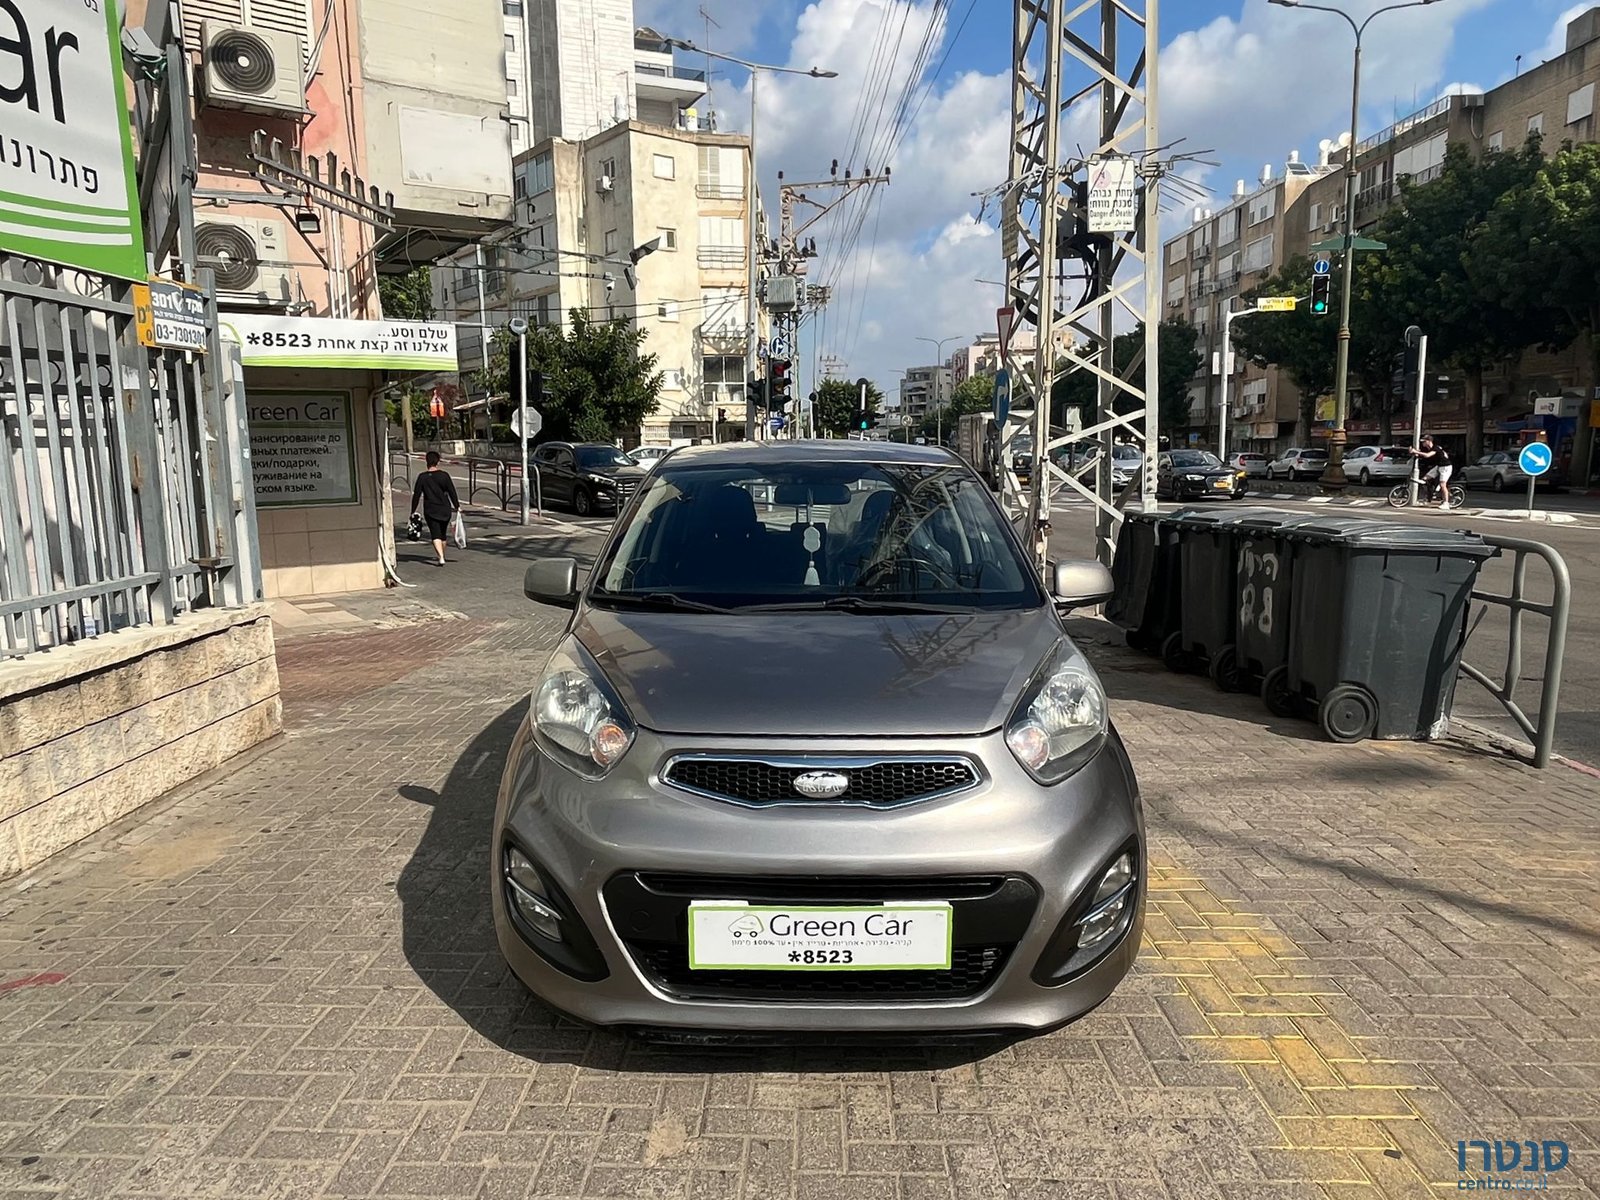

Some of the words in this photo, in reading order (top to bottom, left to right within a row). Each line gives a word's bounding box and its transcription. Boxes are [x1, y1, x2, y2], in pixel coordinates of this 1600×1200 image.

[418, 327, 448, 339] שלם
[317, 338, 356, 350] אחרת
[361, 340, 389, 353] קצת
[393, 340, 408, 351] זה
[413, 340, 449, 352] אצלנו
[248, 406, 299, 421] reen
[304, 402, 339, 421] Car
[328, 434, 341, 444] до
[310, 471, 322, 480] на
[769, 914, 855, 937] Green
[864, 914, 913, 936] Car
